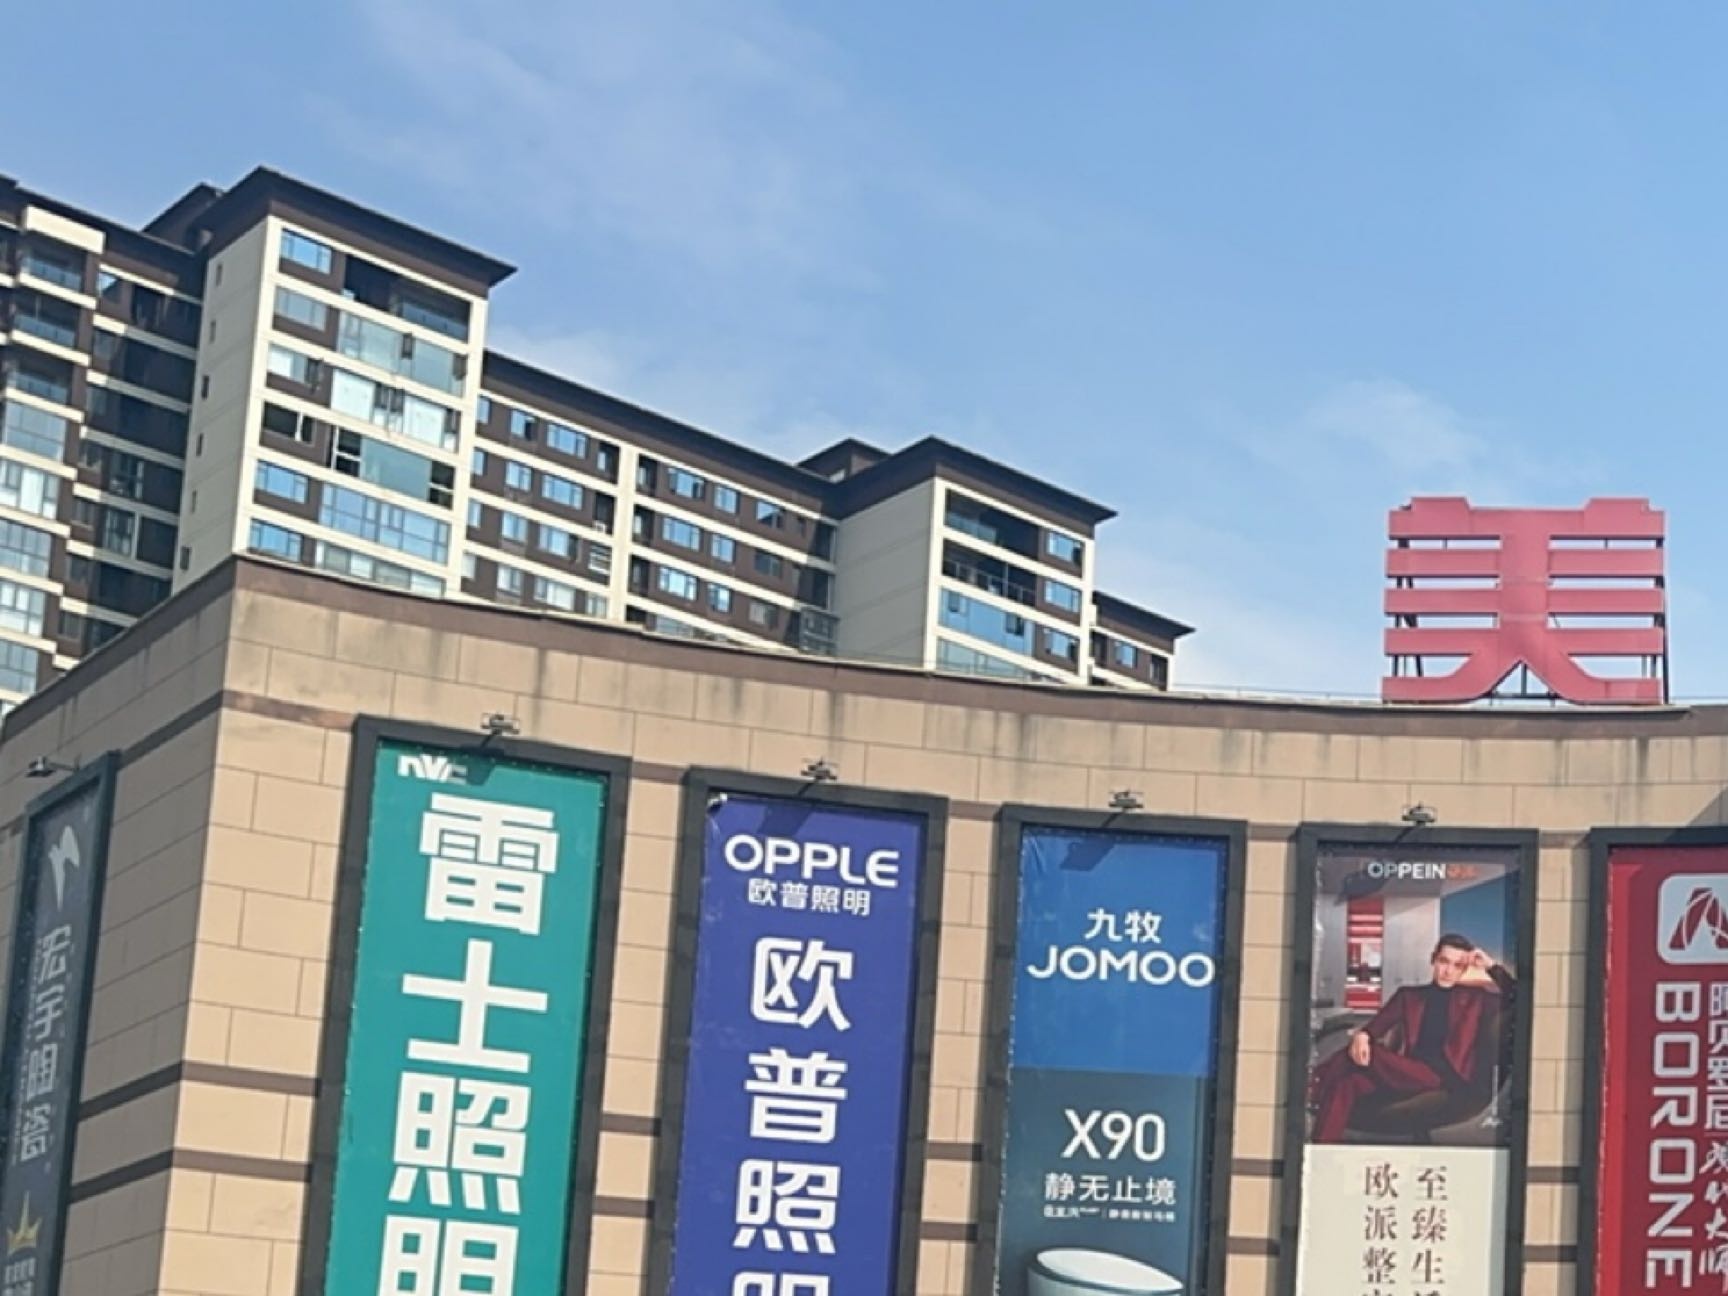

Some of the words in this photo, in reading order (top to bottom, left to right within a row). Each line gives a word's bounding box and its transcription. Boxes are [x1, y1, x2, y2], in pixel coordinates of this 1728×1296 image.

[725, 833, 900, 889] OPPLE
[1367, 862, 1447, 880] OPPEIN
[747, 877, 871, 917] 欧普照明
[1084, 908, 1162, 944] 九牧
[1027, 945, 1216, 988] JOMOO
[1061, 1108, 1167, 1164] X90
[1645, 981, 1701, 1289] BORONE
[1044, 1172, 1176, 1205] 静无止境
